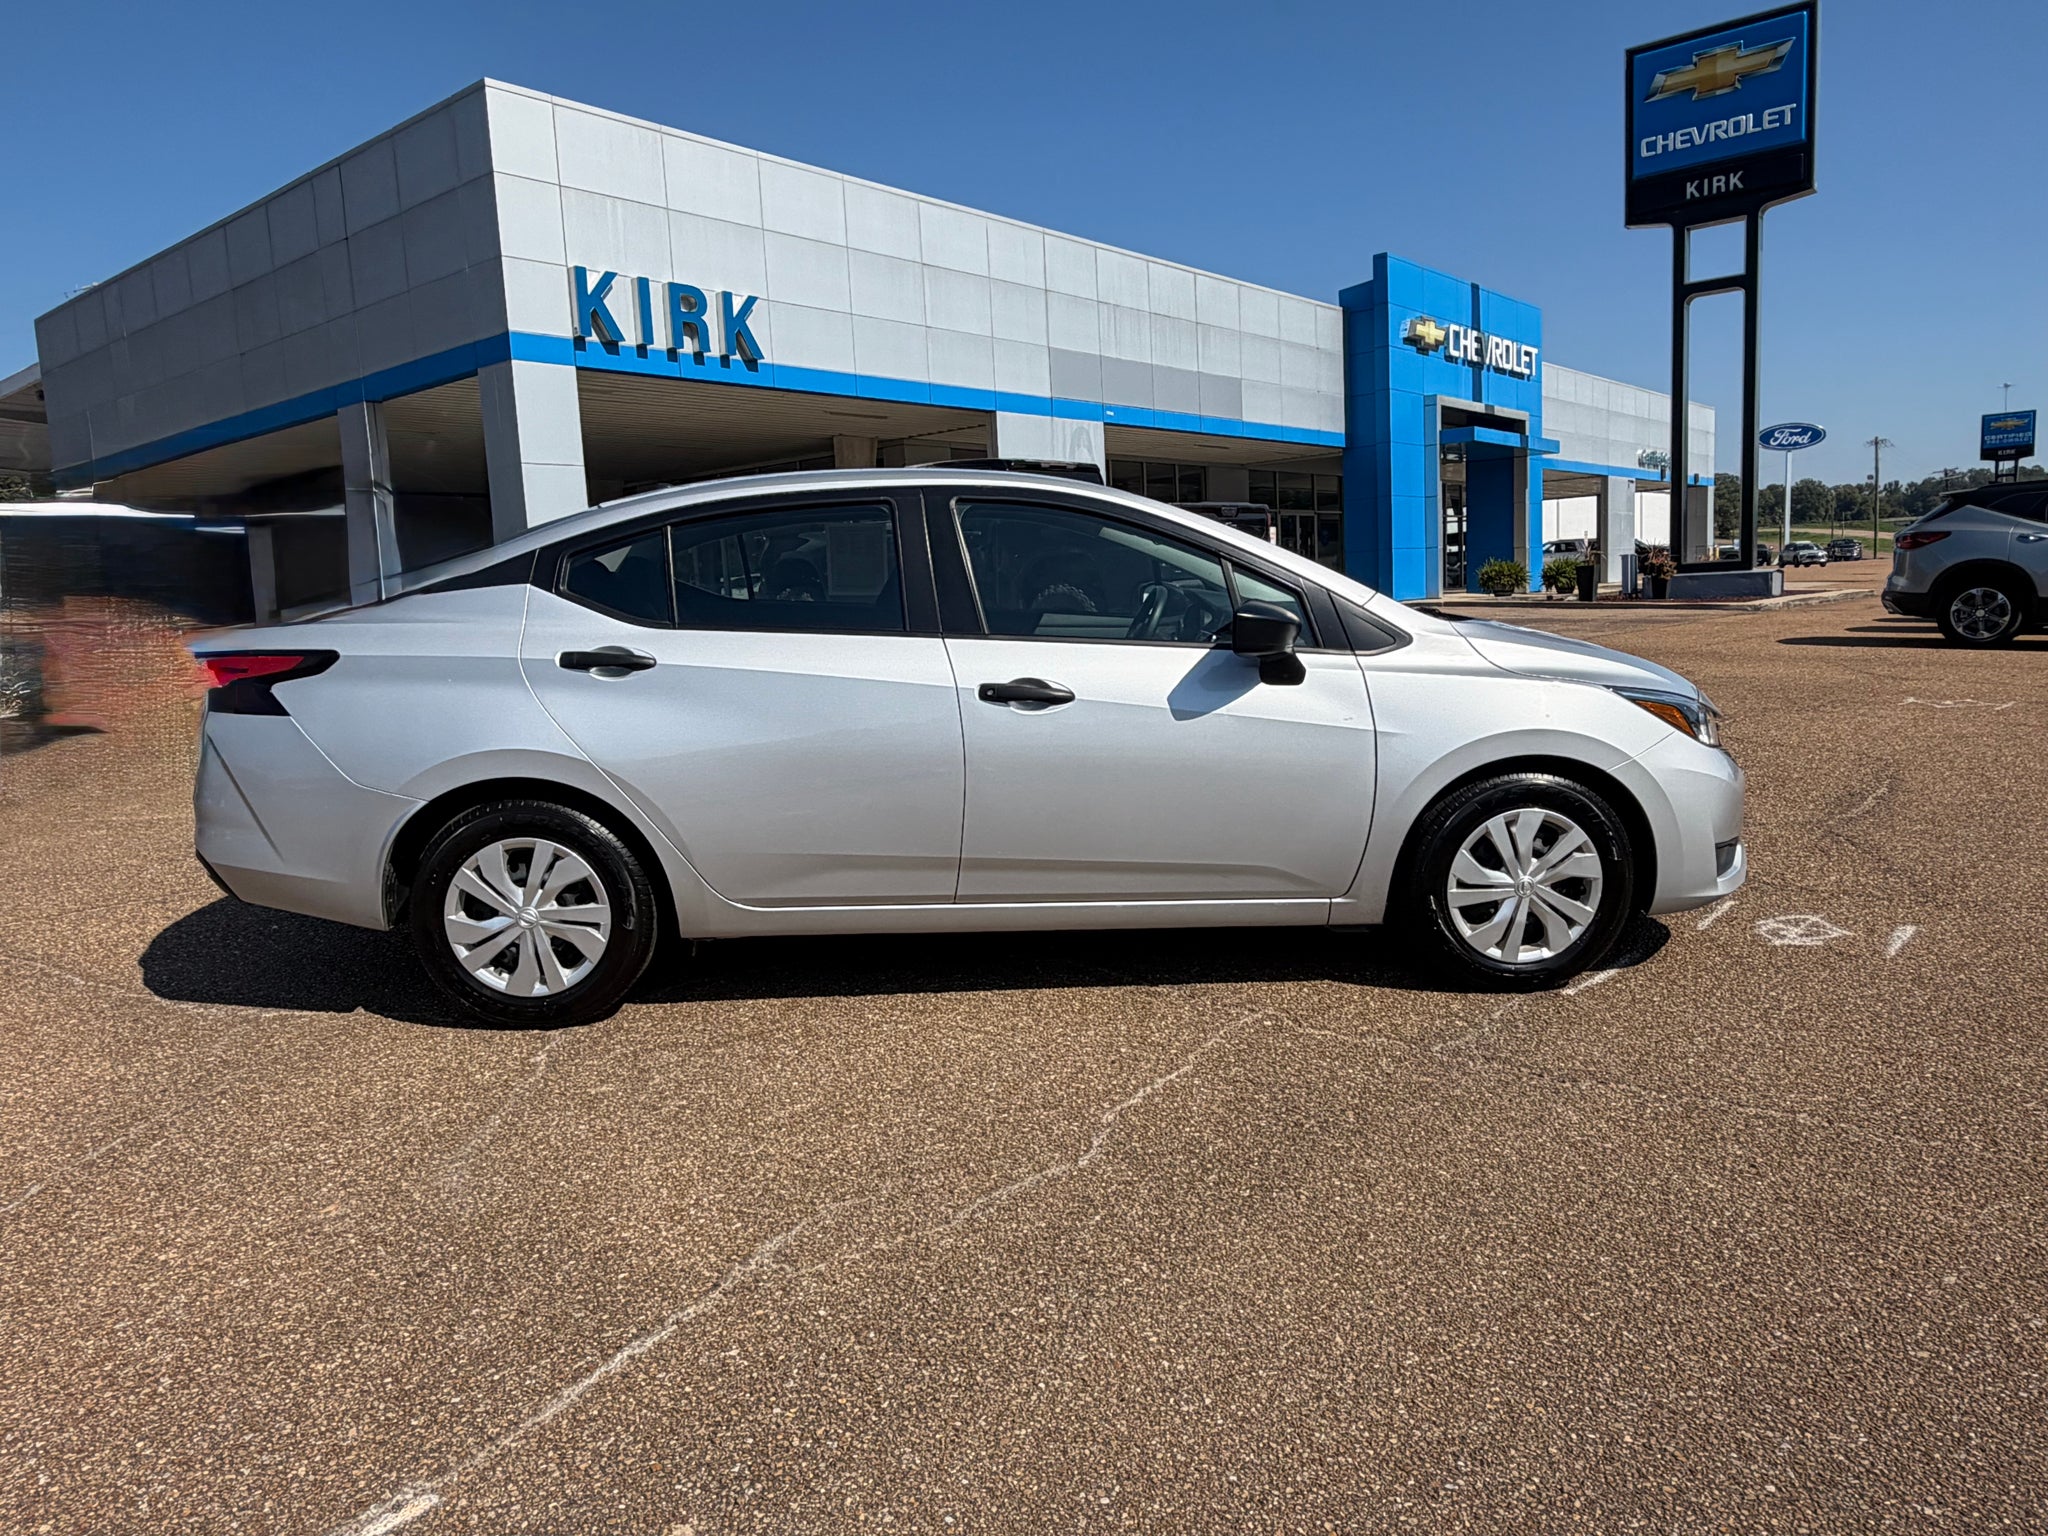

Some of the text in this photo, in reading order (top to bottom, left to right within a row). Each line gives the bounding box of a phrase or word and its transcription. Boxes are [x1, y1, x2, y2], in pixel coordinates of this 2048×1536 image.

[1640, 103, 1797, 158] CHEVROLET
[1685, 170, 1745, 200] KIRK
[568, 265, 765, 361] KIRK
[1448, 323, 1539, 377] CHEVROLET
[1769, 428, 1813, 446] Ford
